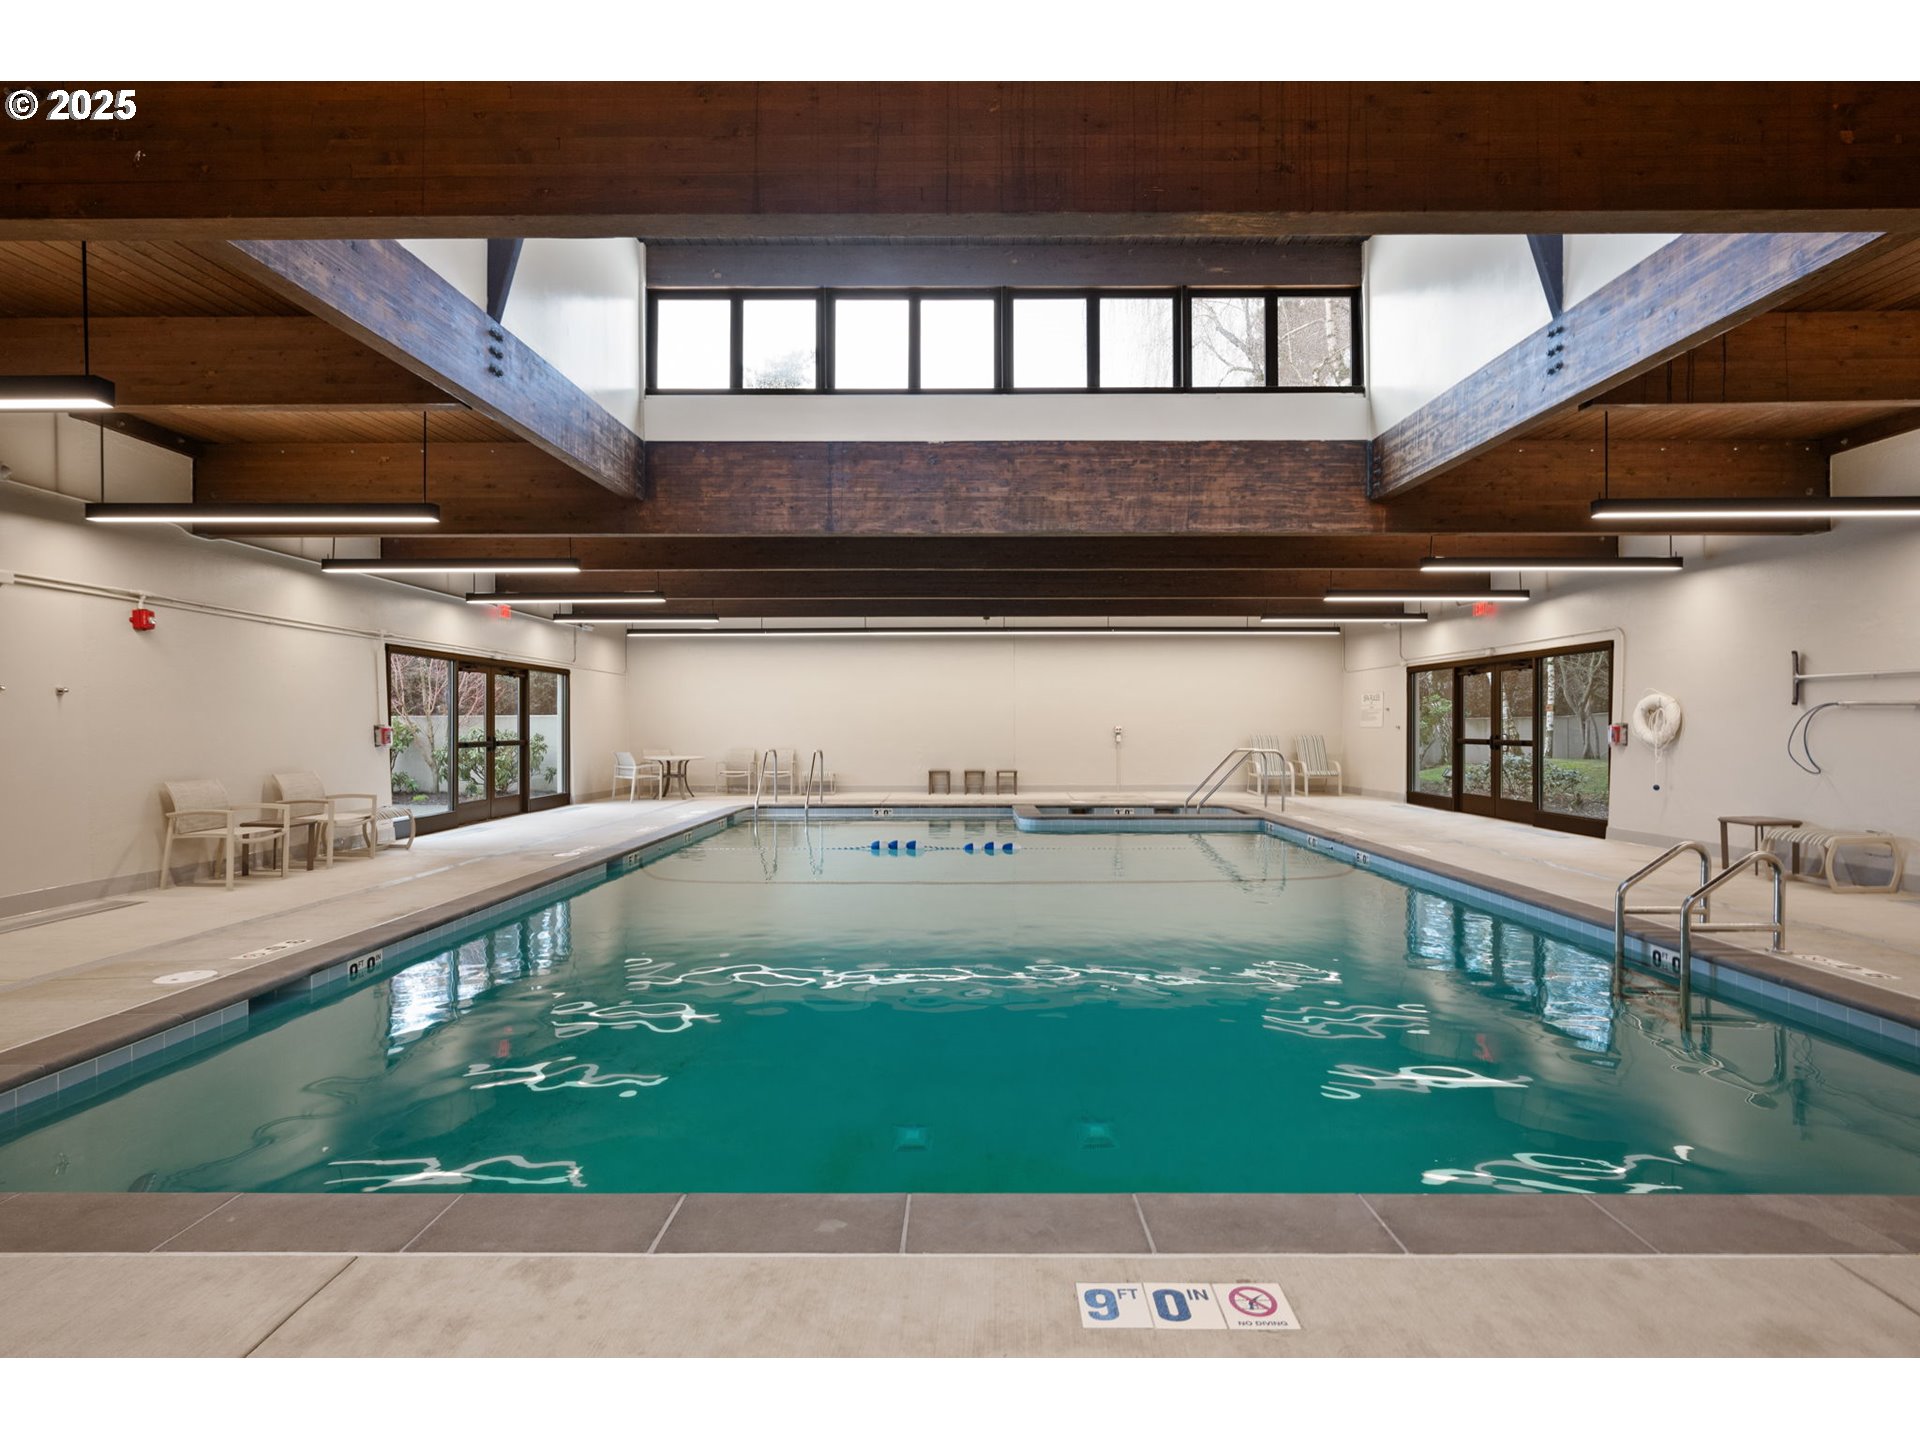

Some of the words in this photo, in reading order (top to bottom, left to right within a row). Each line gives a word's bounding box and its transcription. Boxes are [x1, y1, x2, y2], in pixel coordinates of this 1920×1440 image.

[1084, 1288, 1120, 1321] 9
[1117, 1288, 1138, 1300] FT
[1152, 1288, 1192, 1322] 0
[1186, 1288, 1210, 1301] IN
